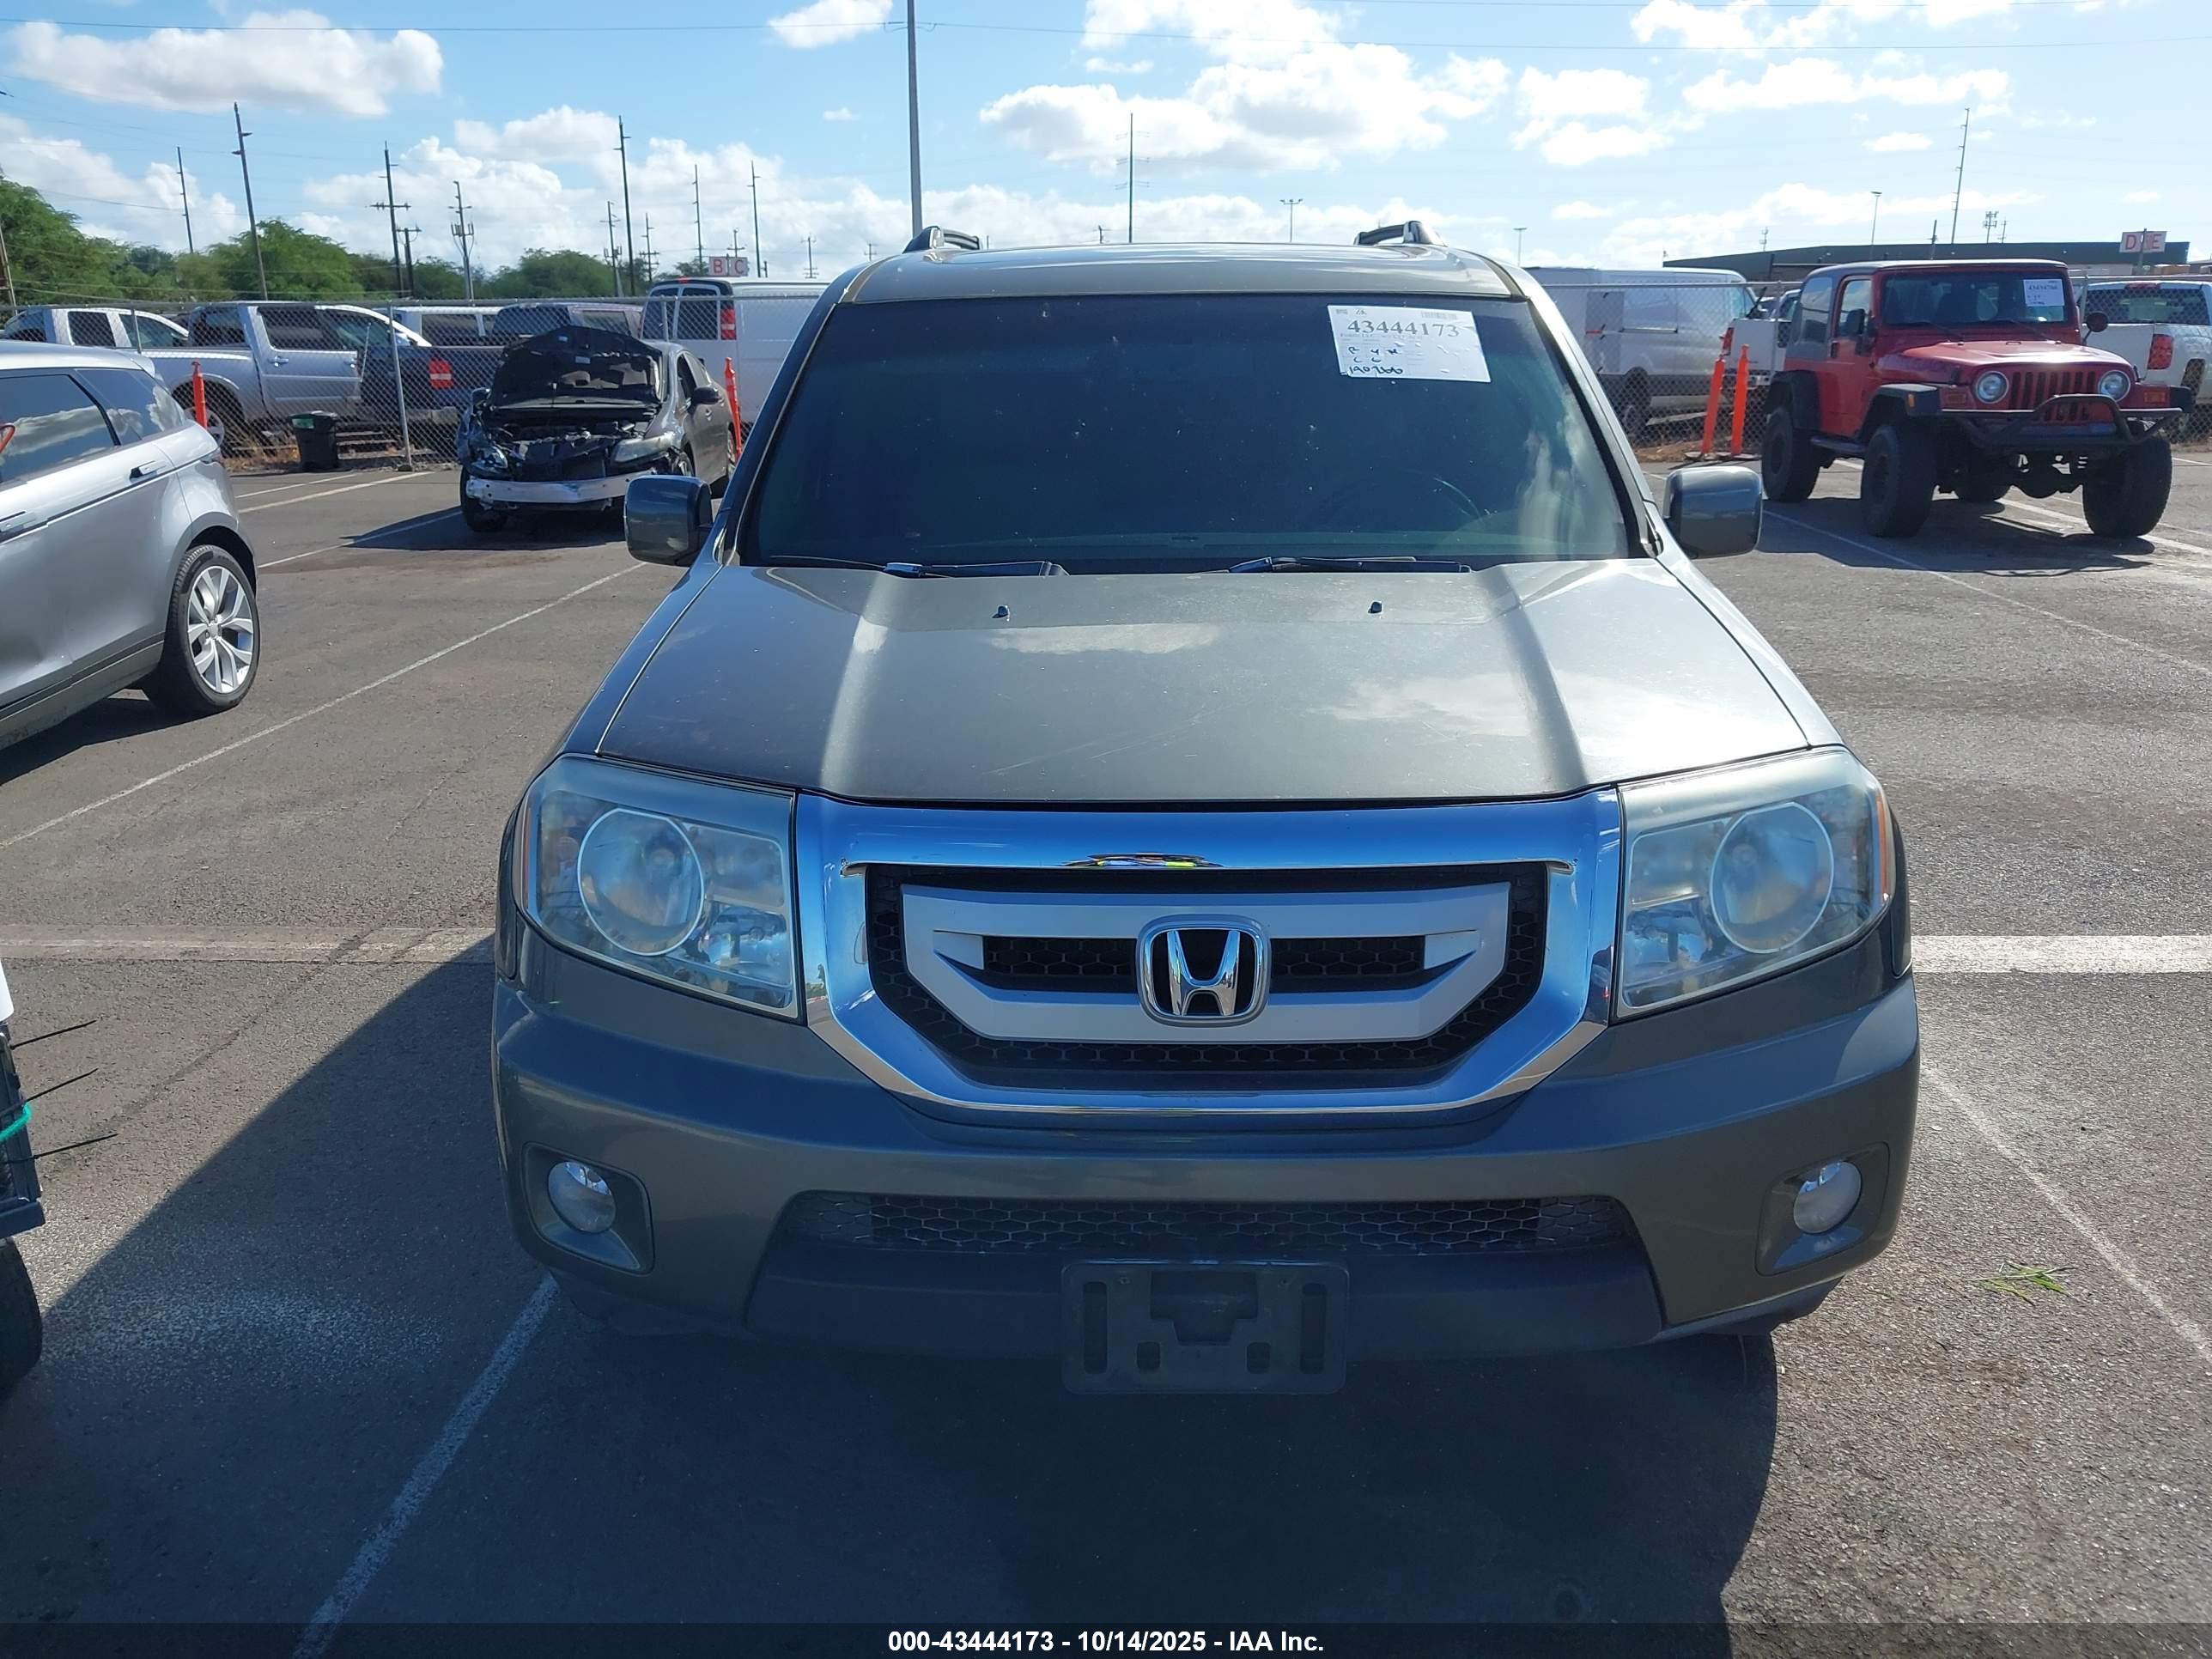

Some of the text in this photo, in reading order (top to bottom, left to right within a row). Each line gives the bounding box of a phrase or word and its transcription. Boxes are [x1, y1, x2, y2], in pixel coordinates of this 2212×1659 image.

[2125, 234, 2137, 250] D
[2151, 234, 2162, 249] E
[713, 258, 723, 274] B
[734, 259, 744, 274] C
[1347, 320, 1460, 337] 43444173
